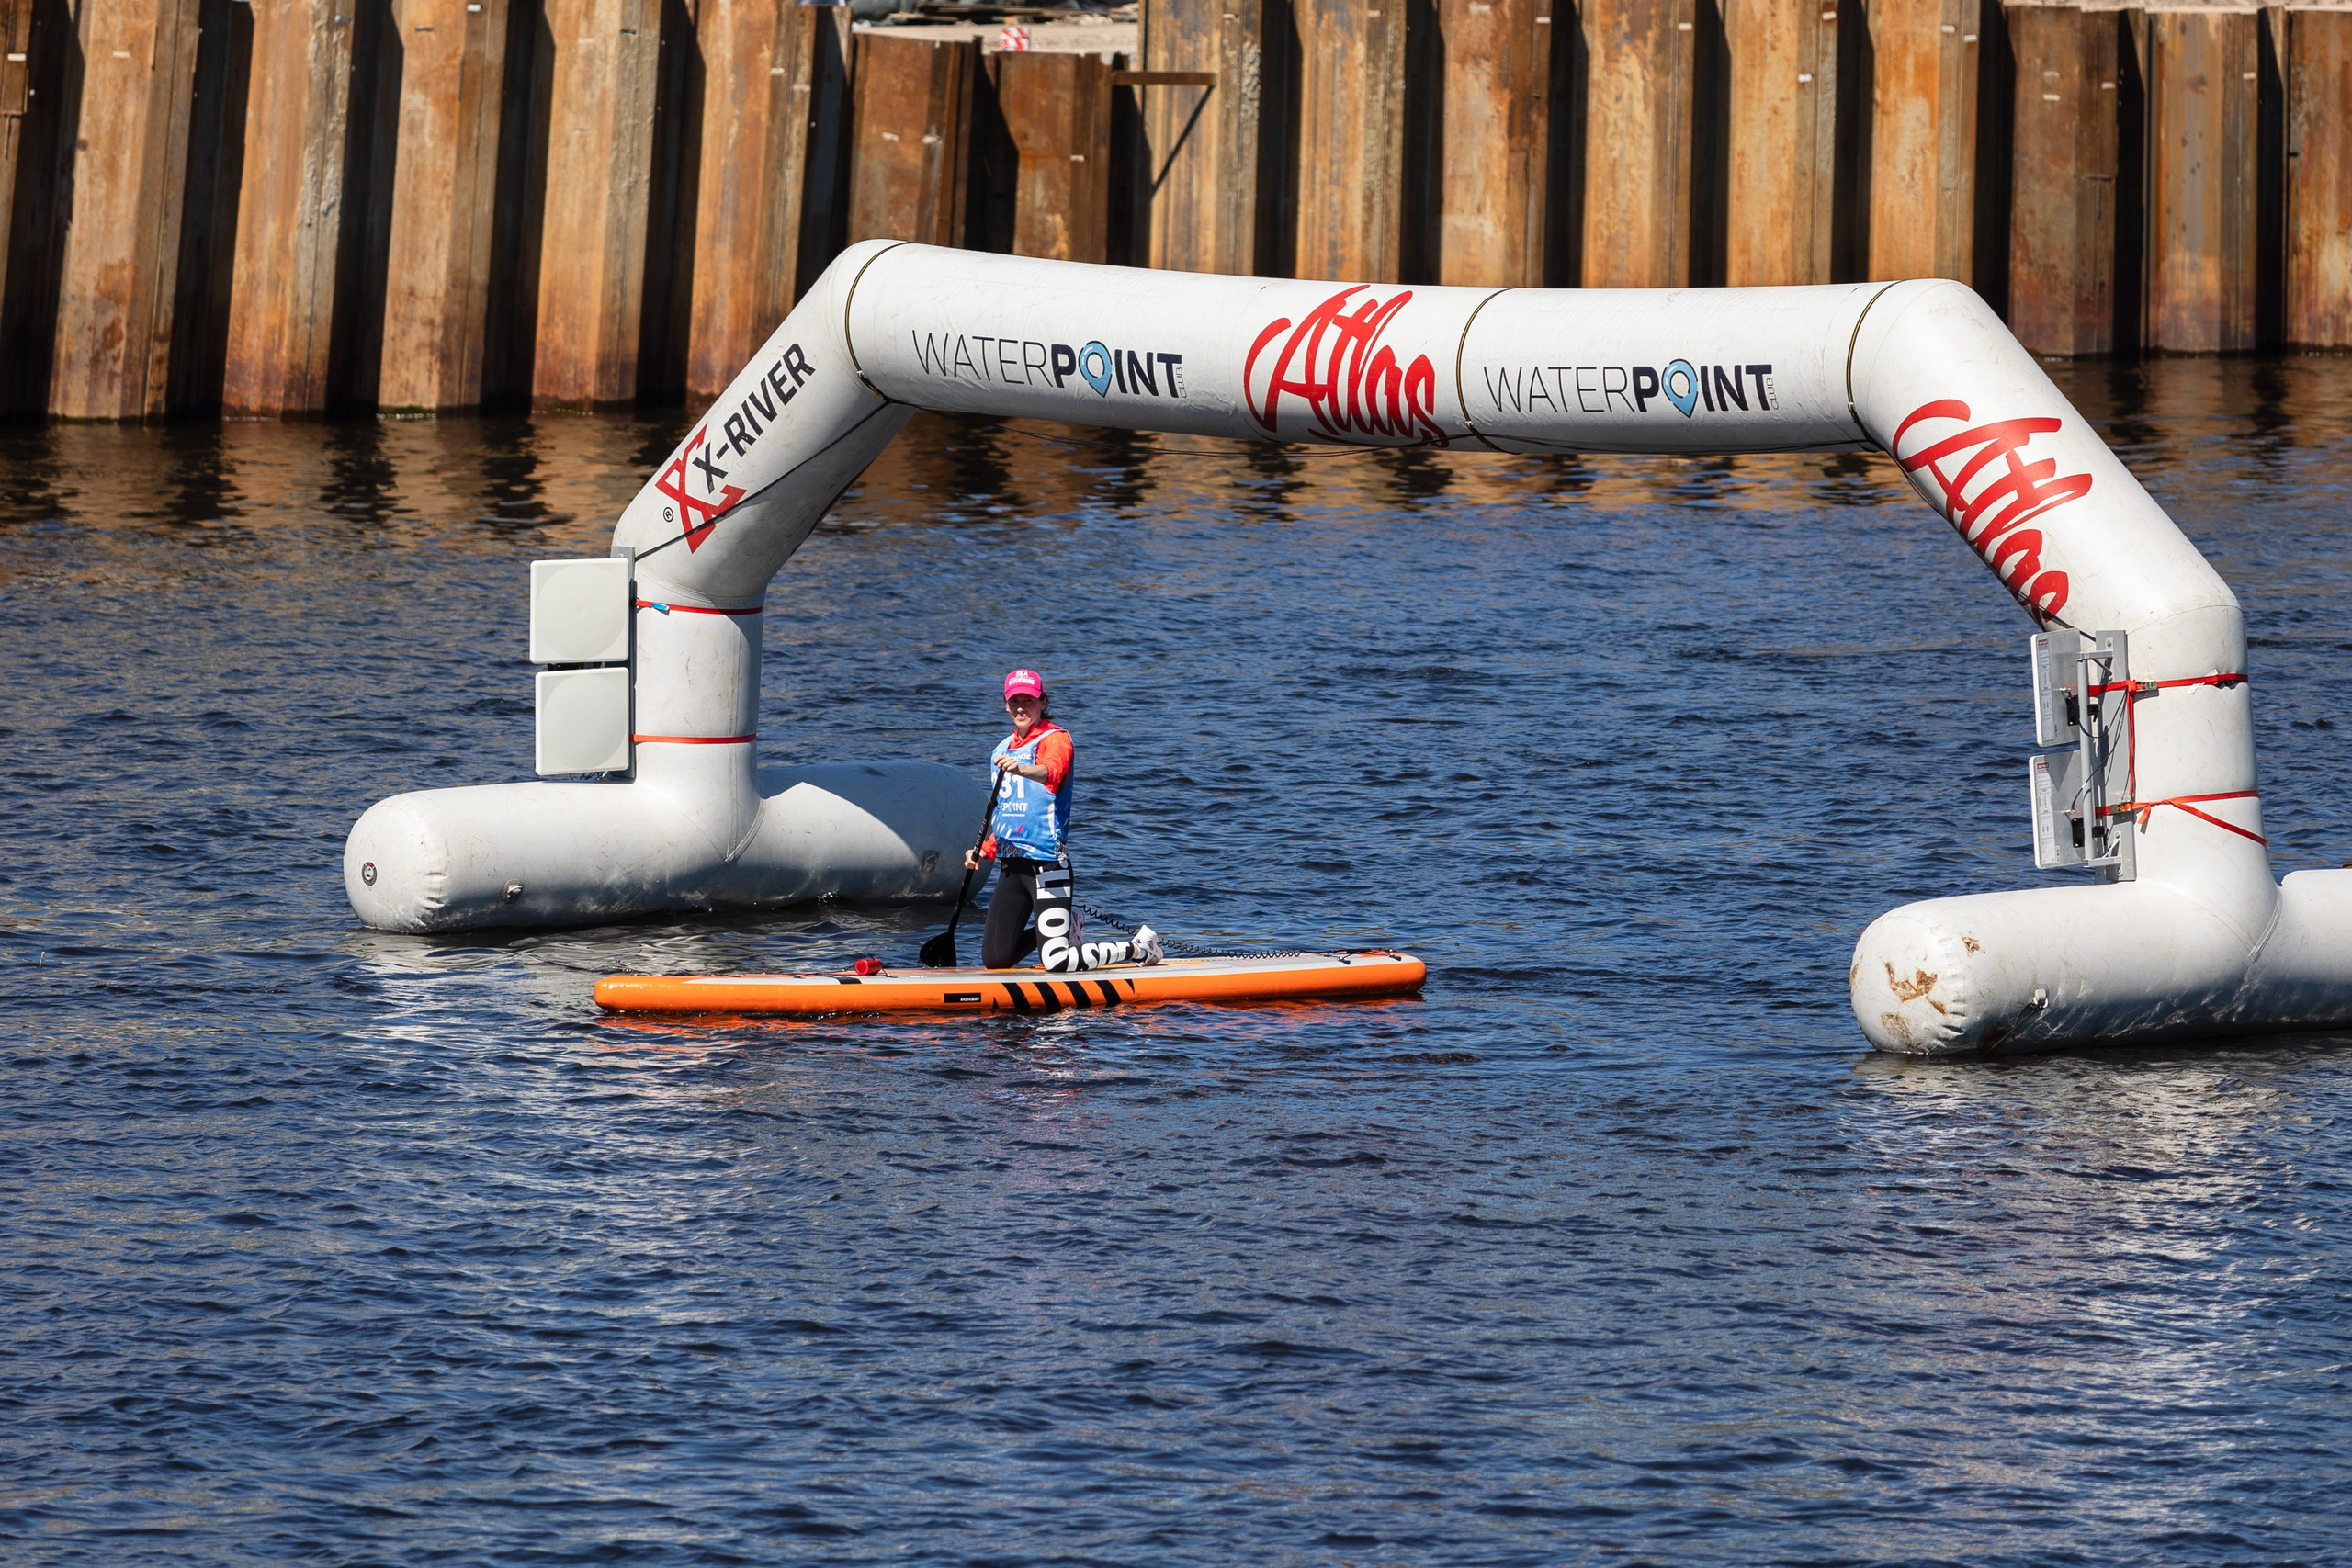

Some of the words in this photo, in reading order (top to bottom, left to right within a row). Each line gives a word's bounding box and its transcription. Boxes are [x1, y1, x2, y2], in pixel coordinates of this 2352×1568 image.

[911, 329, 1182, 399] WATERPOINT
[1178, 367, 1187, 399] CLUB
[1243, 284, 1450, 448] Atlas
[1483, 358, 1772, 419] WATERPOINT
[1770, 377, 1780, 411] CLUB
[692, 343, 816, 494] X-RIVER
